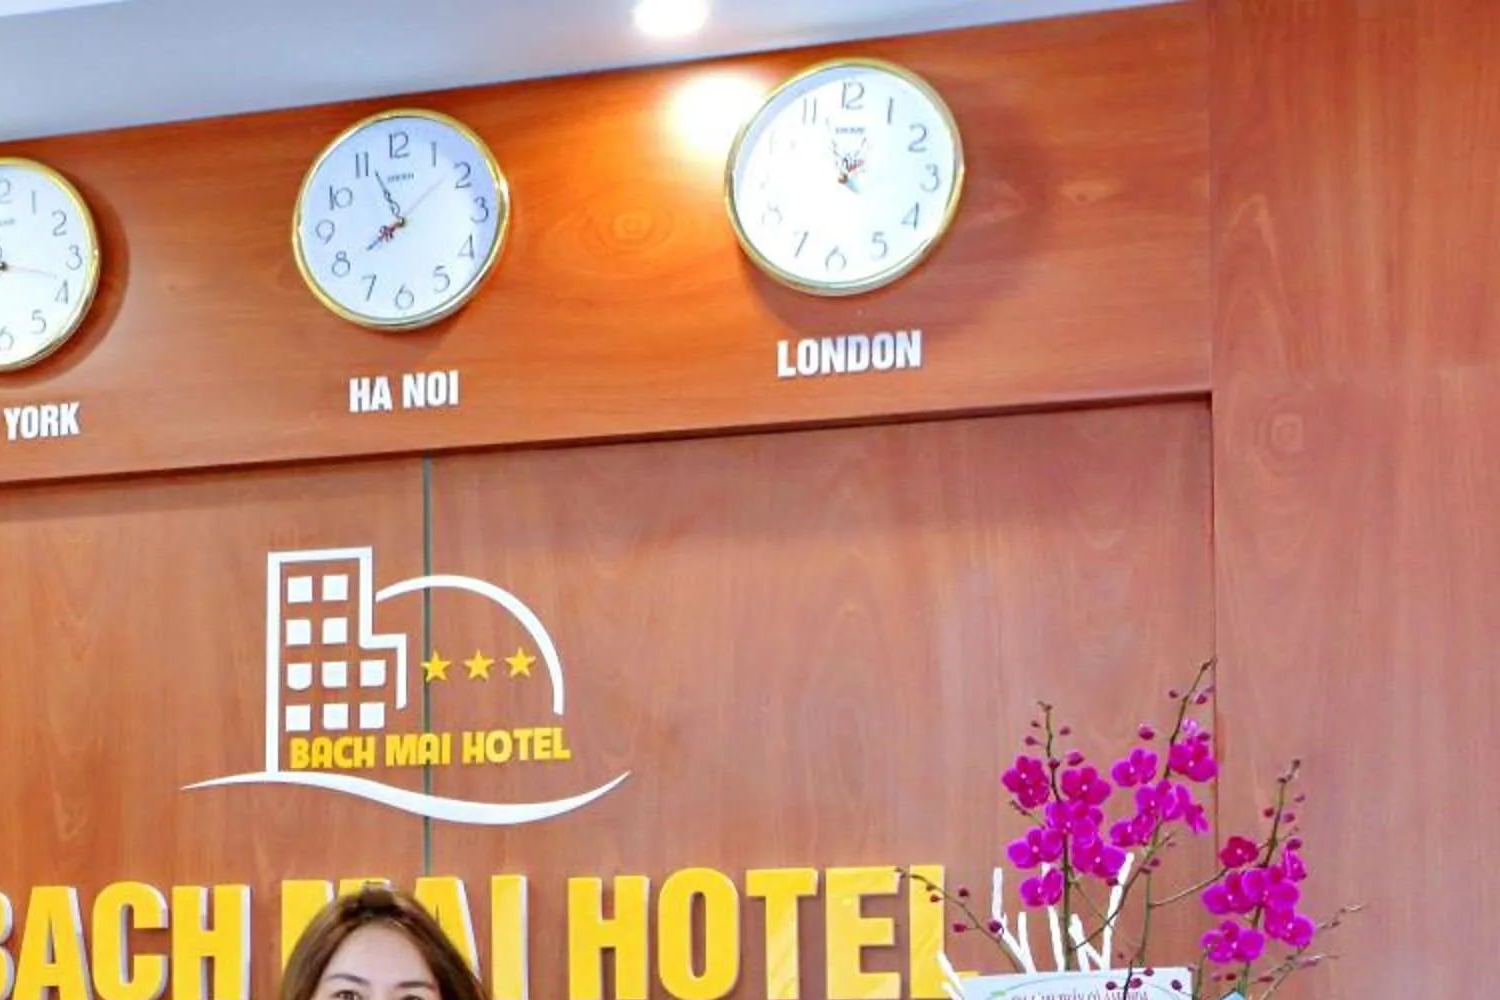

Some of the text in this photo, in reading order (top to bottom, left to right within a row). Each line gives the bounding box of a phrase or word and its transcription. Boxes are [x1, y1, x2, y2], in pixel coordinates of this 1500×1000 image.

[841, 81, 865, 110] 12
[802, 97, 817, 125] 11
[886, 96, 894, 125] 1
[389, 132, 409, 159] 12
[908, 124, 927, 153] 2
[355, 152, 370, 178] 11
[430, 141, 437, 167] 1
[454, 162, 471, 188] 2
[920, 164, 940, 192] 3
[31, 190, 37, 214] 1
[329, 185, 353, 210] 10
[470, 197, 489, 223] 3
[52, 209, 67, 236] 2
[900, 201, 919, 230] 4
[315, 219, 335, 244] 9
[66, 245, 82, 270] 3
[458, 234, 475, 260] 4
[872, 232, 888, 260] 5
[332, 251, 350, 277] 8
[55, 280, 69, 304] 4
[362, 274, 377, 301] 7
[433, 266, 450, 292] 5
[395, 285, 414, 309] 6
[31, 309, 47, 334] 5
[777, 330, 921, 377] LONDON
[349, 370, 459, 412] HA NOI
[3, 402, 80, 441] YORK
[290, 727, 571, 769] BACH MAI HOTEL
